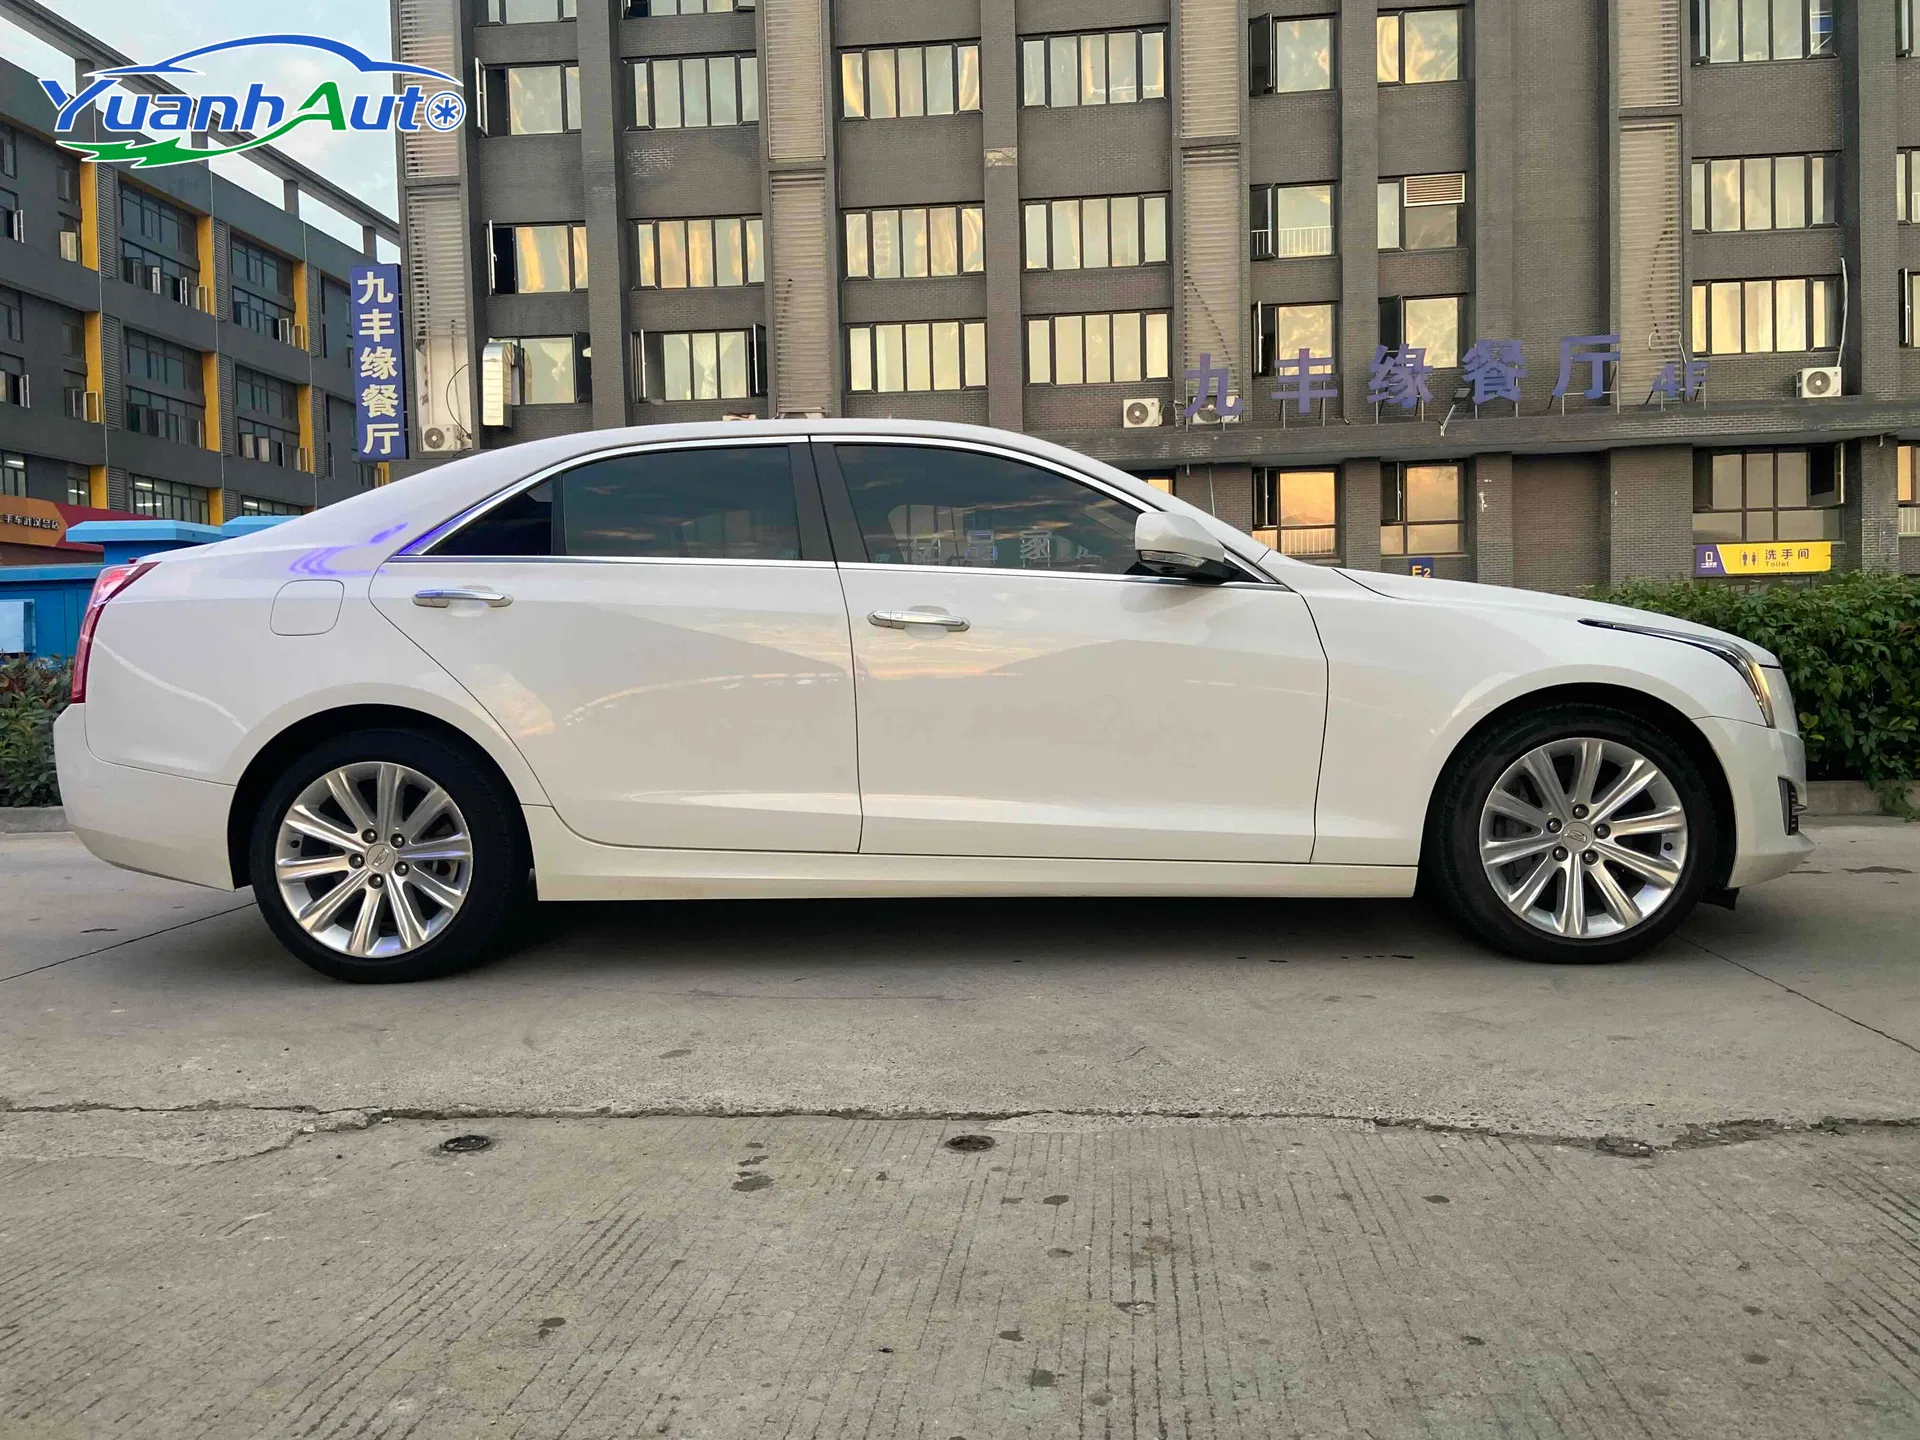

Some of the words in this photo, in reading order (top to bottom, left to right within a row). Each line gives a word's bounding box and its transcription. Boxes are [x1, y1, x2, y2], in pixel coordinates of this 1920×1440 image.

[357, 271, 400, 455] 九丰缘餐厅
[1183, 334, 1620, 418] 九丰缘餐厅
[1653, 362, 1710, 398] 4F
[1765, 548, 1810, 560] 洗手间
